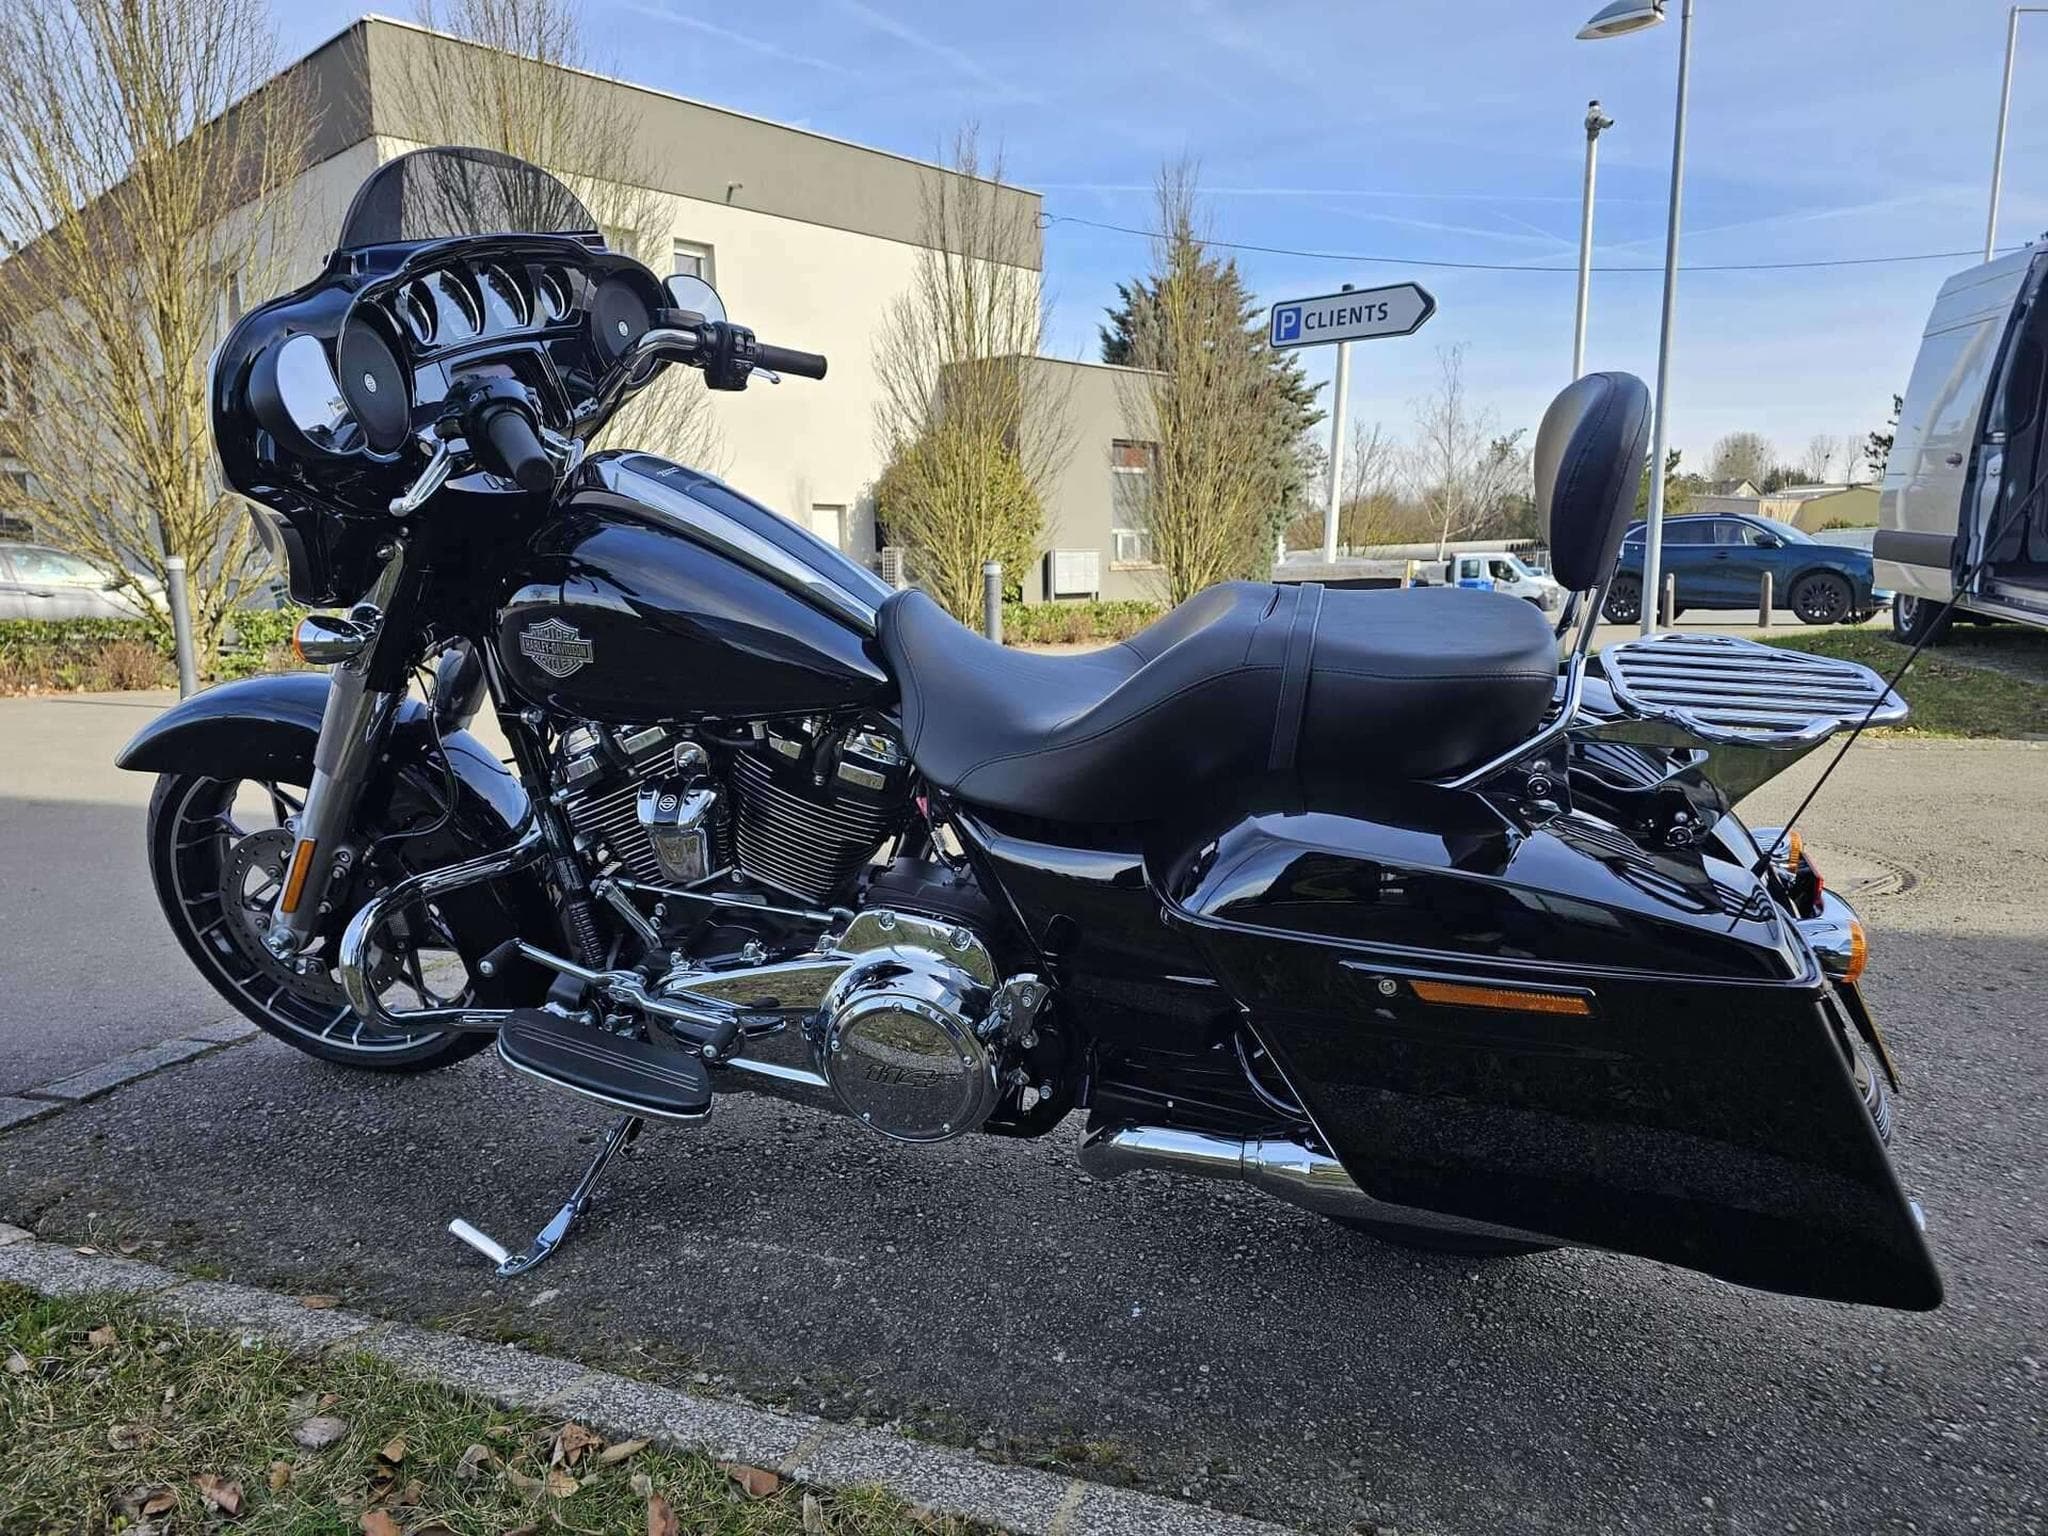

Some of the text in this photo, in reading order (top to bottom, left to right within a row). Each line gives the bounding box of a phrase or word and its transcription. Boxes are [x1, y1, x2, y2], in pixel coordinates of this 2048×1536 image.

[1280, 302, 1388, 338] P CLIENTS
[525, 639, 587, 657] HARLEY-DAVIDSON
